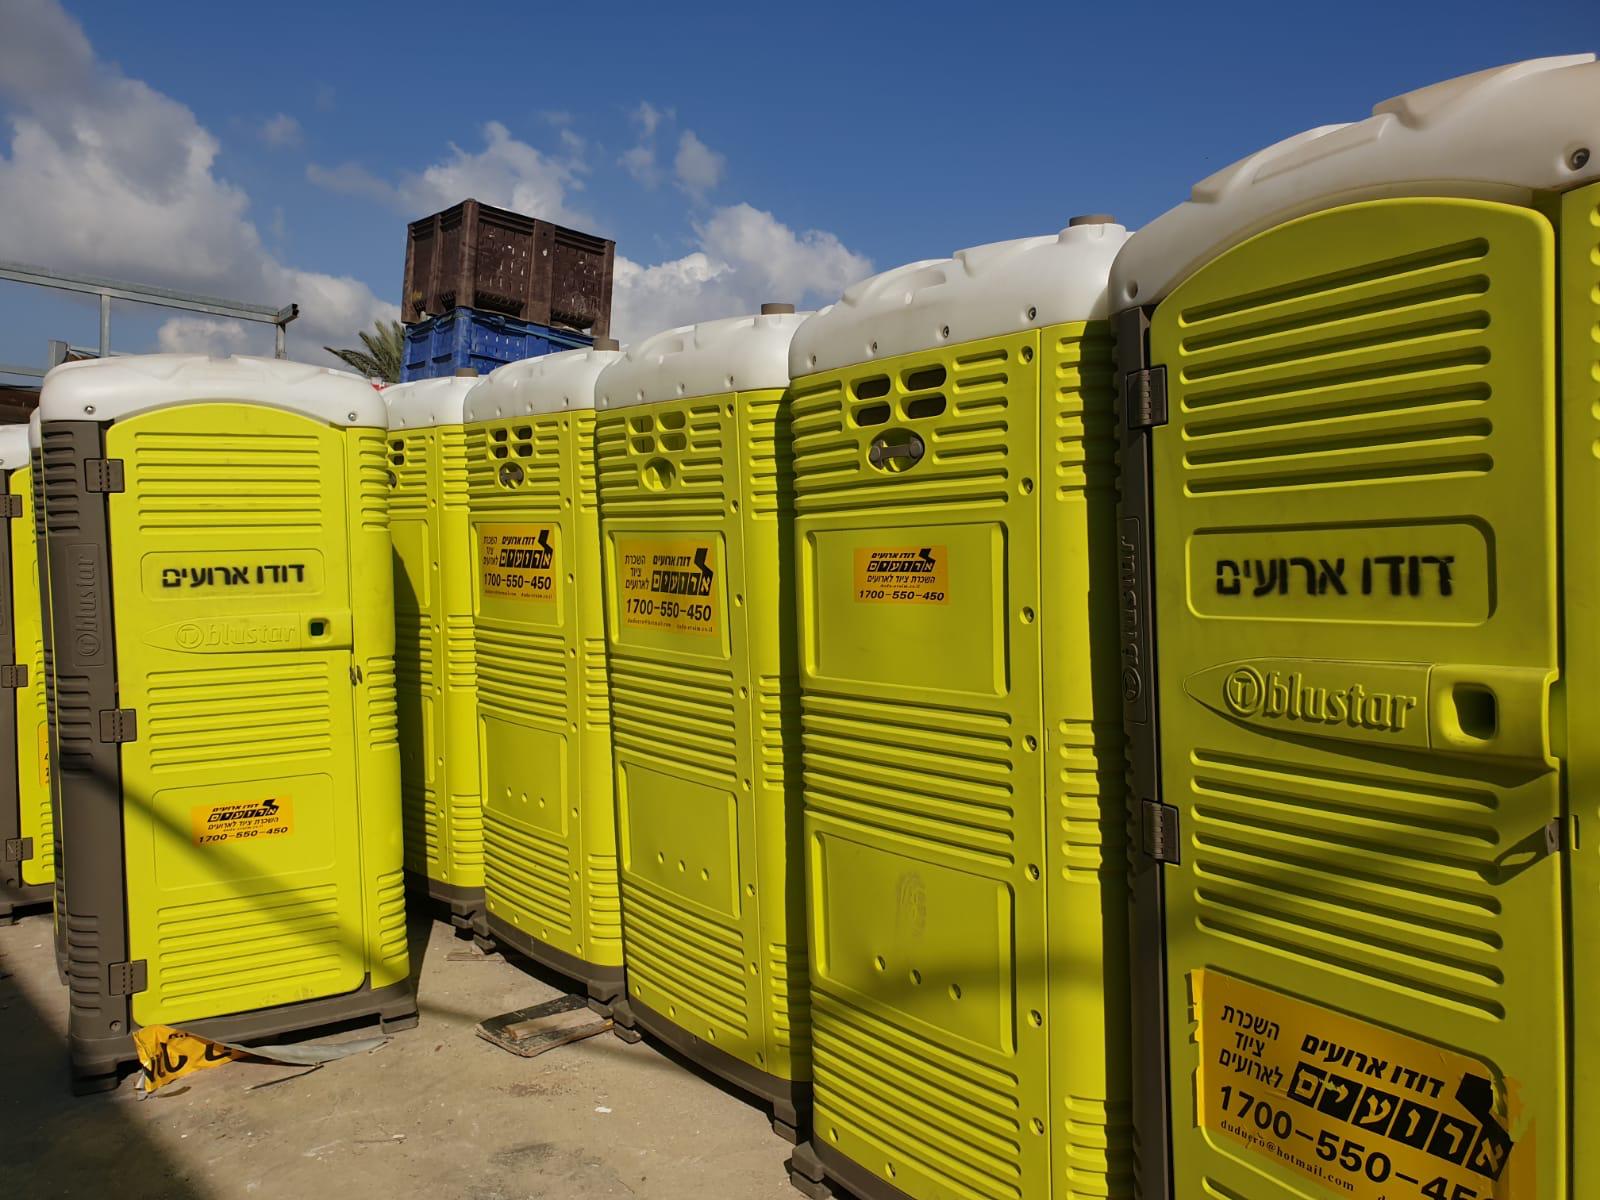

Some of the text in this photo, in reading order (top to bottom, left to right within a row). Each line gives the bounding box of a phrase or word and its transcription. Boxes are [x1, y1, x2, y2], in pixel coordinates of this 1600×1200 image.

[499, 549, 553, 569] ארועים
[866, 560, 936, 572] ארועים
[162, 564, 305, 588] דודו ארועים
[484, 573, 552, 590] 1700-550-450
[651, 570, 713, 596] ארועים
[1216, 555, 1455, 598] דודו ארועים
[859, 590, 944, 601] 1700-550-450
[626, 598, 712, 621] 1700-550-450
[1263, 671, 1417, 731] blustar
[207, 806, 279, 823] ארועים
[199, 827, 288, 843] 1700-550-450
[1221, 1005, 1280, 1041] השכרת
[1235, 1031, 1265, 1058] ציוד
[1218, 1048, 1284, 1088] לארועים
[1300, 1034, 1446, 1099] דודו ארועים
[1286, 1061, 1513, 1182] ארועים
[1220, 1085, 1493, 1200] 1700-550-45
